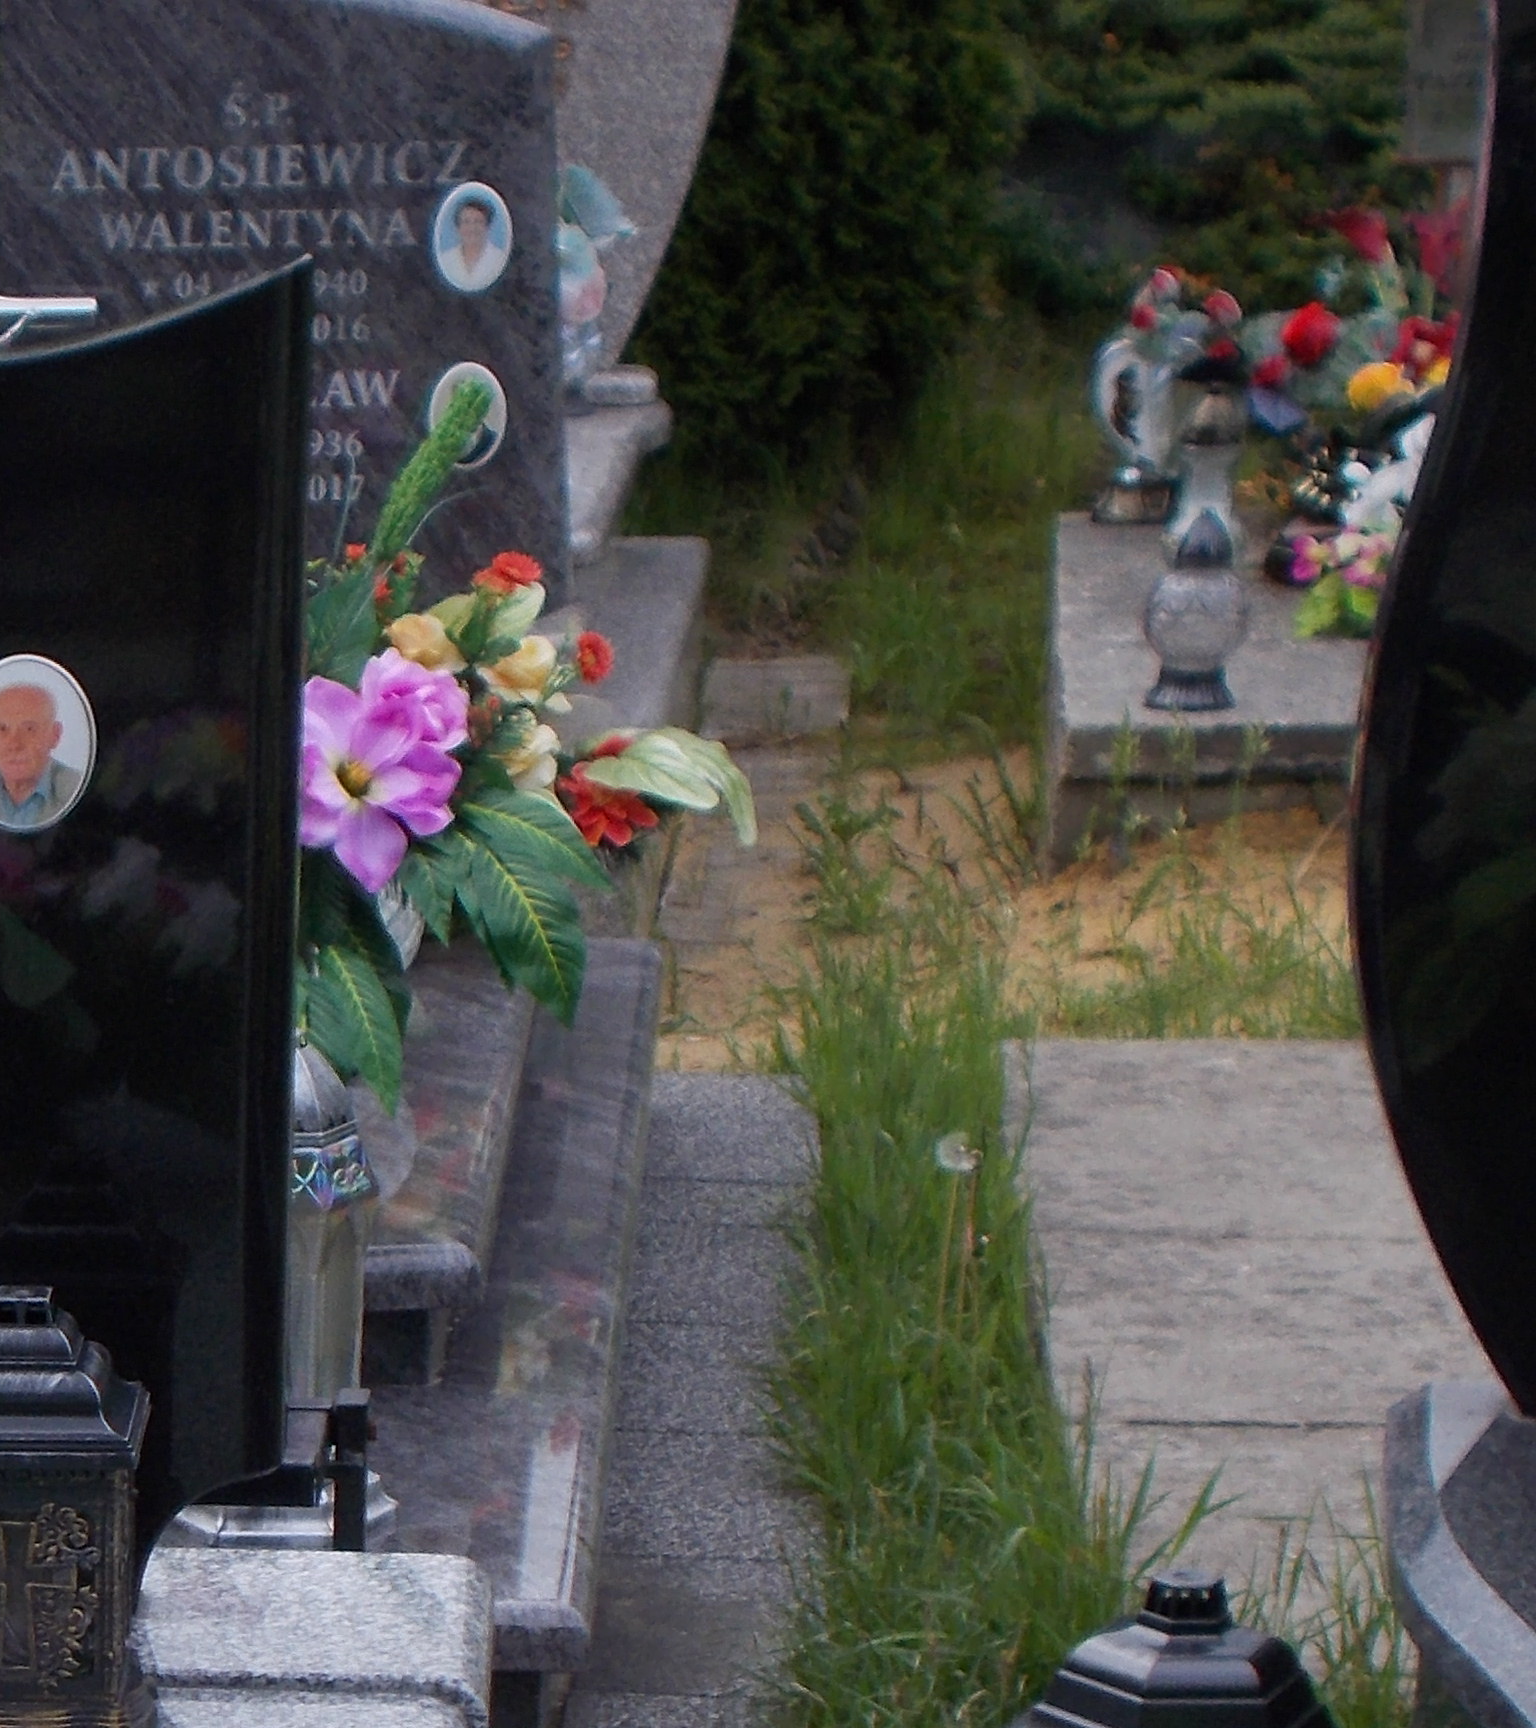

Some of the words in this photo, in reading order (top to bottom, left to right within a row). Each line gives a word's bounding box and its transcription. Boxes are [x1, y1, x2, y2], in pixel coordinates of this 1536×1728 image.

[52, 139, 471, 192] ANTOSIEWICZ
[99, 206, 419, 249] WALENTYNA
[312, 267, 368, 296] 940
[310, 312, 371, 343] 016
[311, 368, 401, 408] AW
[309, 428, 364, 458] 936
[308, 472, 366, 502] 017
